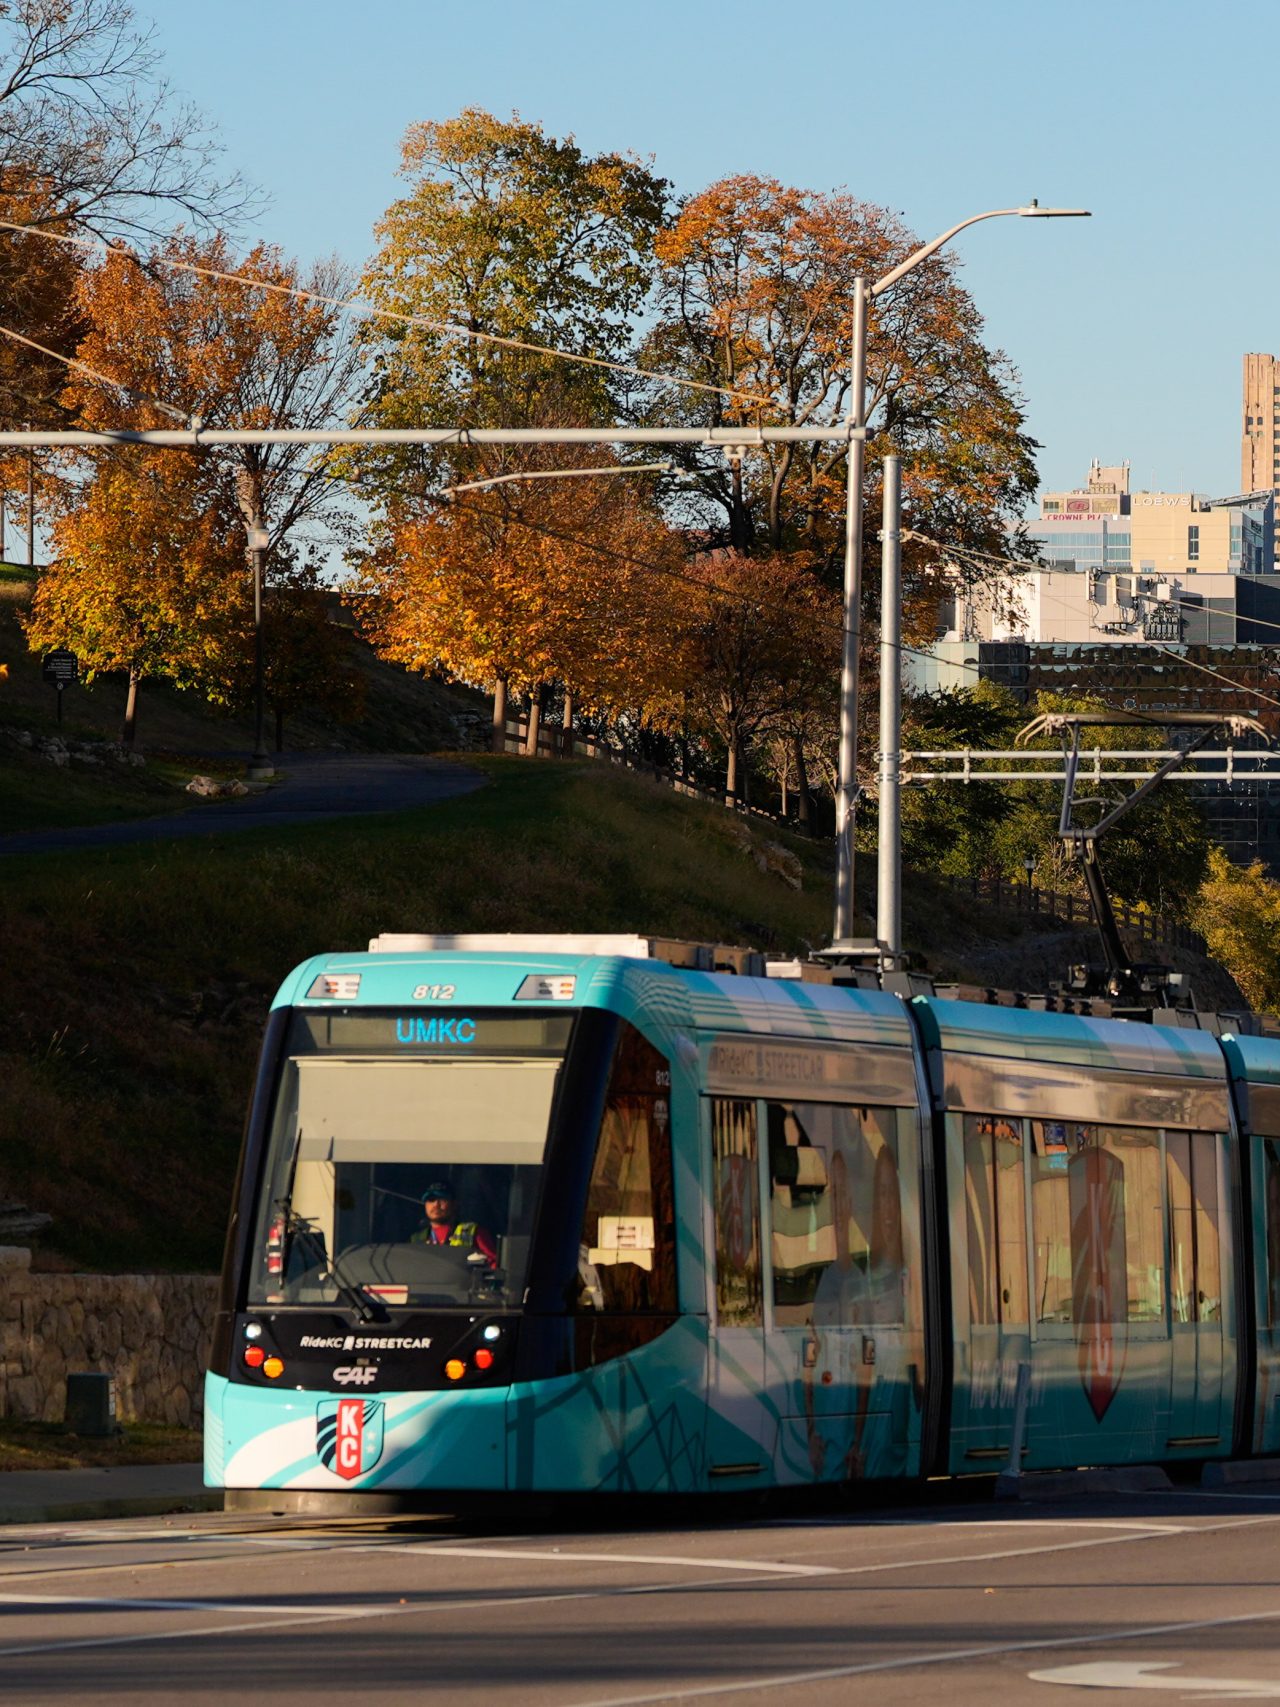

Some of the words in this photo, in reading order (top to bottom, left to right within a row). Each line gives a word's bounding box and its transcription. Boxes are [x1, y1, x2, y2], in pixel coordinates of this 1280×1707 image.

[1134, 497, 1190, 506] LOEWS
[412, 985, 456, 1000] 812
[396, 1018, 476, 1043] UMKC
[656, 1070, 670, 1086] 812
[300, 1336, 344, 1349] RideKC
[354, 1337, 432, 1349] STREETCAR
[332, 1366, 378, 1386] CAF
[340, 1405, 359, 1468] KC
